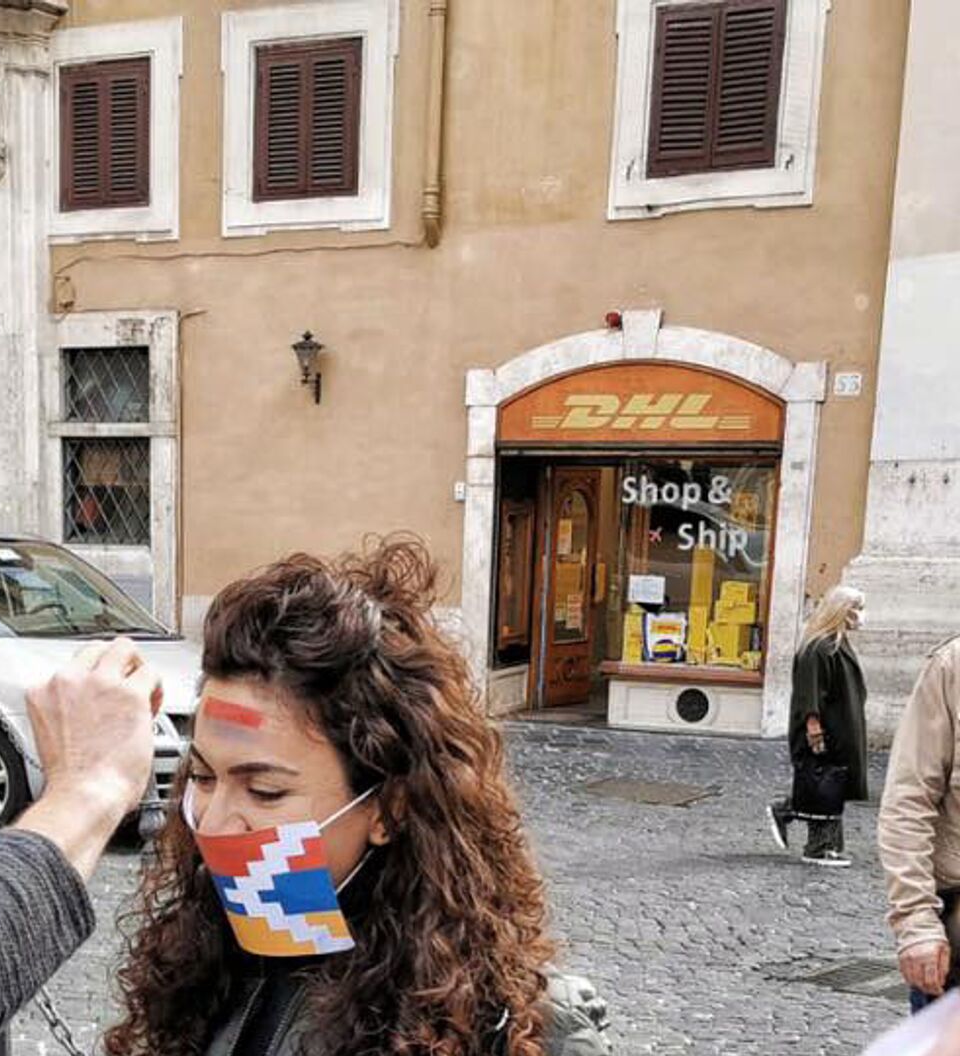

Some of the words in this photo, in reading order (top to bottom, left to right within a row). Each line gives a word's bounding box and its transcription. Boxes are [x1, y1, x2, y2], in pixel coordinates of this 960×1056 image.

[559, 393, 713, 429] DHL
[621, 474, 702, 511] Shop
[707, 475, 732, 504] &
[677, 520, 748, 557] Ship
